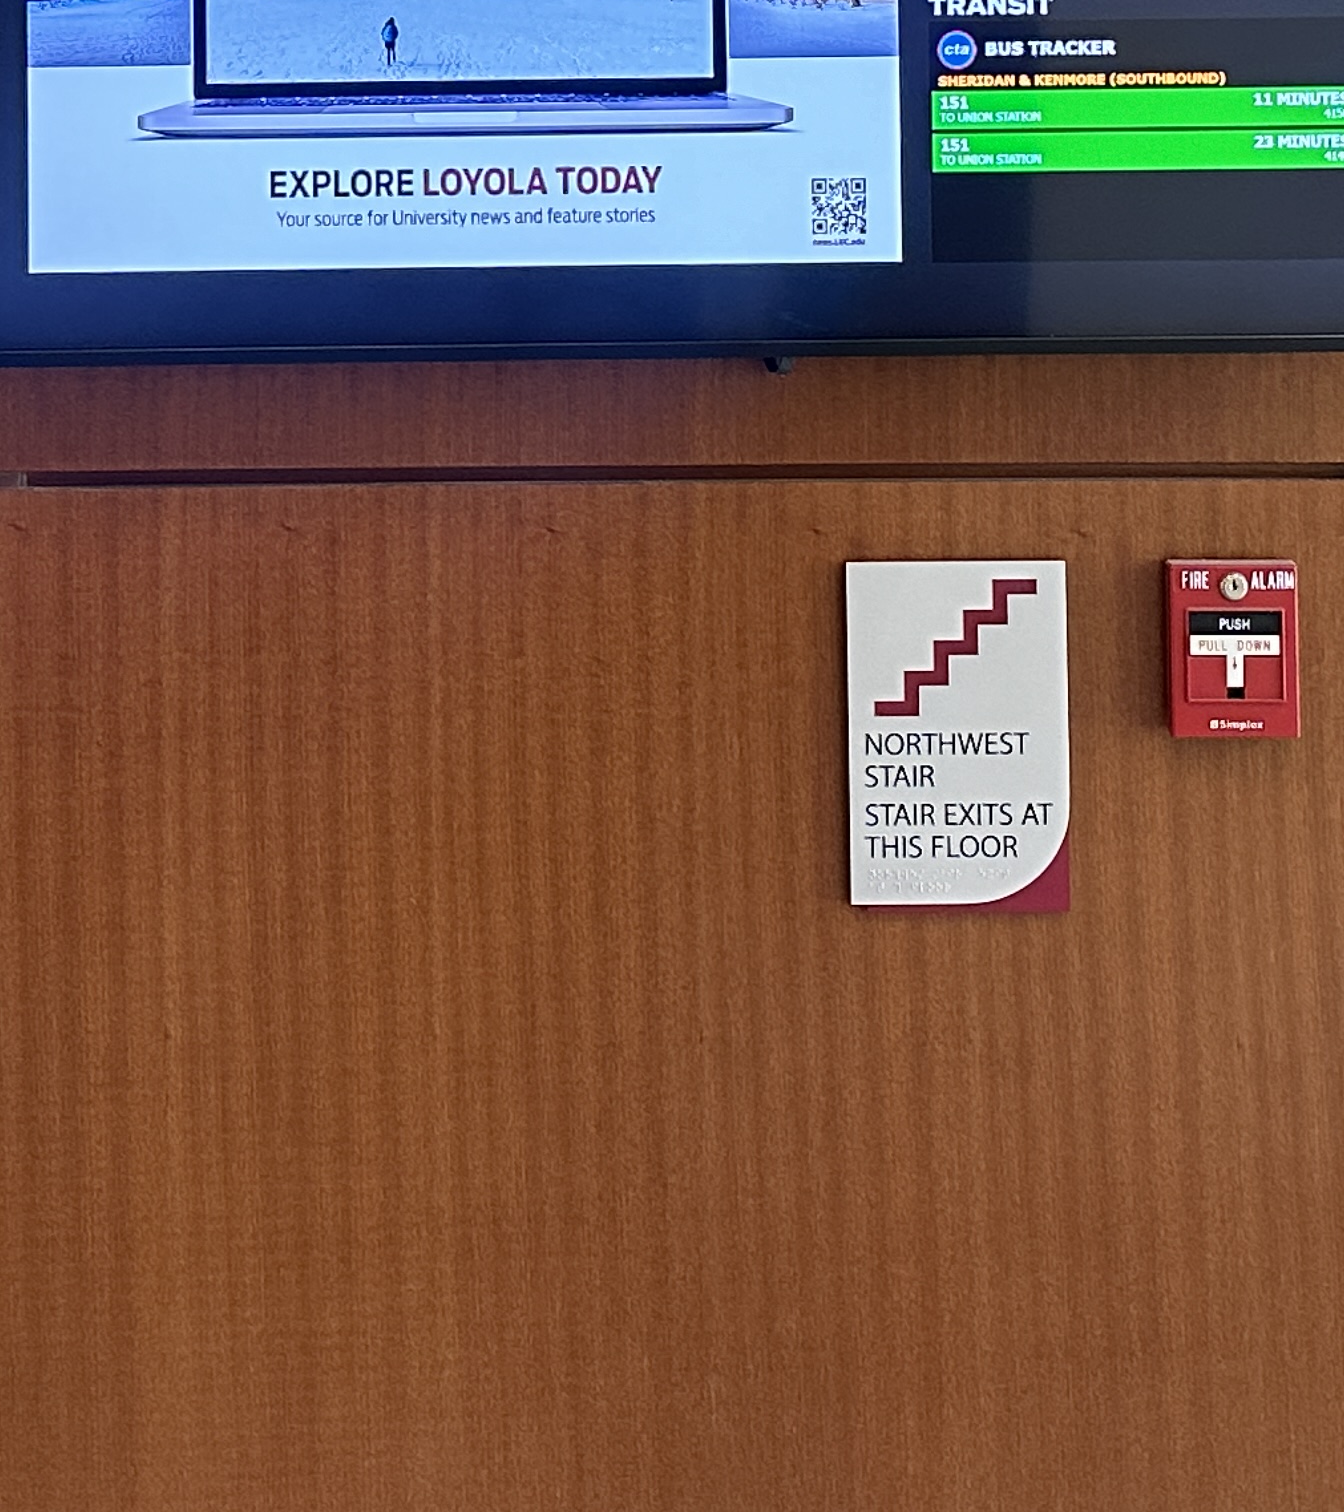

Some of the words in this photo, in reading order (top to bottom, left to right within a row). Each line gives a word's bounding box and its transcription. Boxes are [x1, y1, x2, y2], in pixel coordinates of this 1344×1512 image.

[943, 43, 970, 56] cta
[985, 41, 1024, 56] BUS
[1028, 39, 1116, 56] TRACKER
[937, 74, 1015, 87] SHERIDAN
[1019, 74, 1032, 86] &
[1034, 73, 1106, 86] KENMORE
[1109, 71, 1227, 87] (SOUTHBOUND)
[939, 96, 969, 110] 151
[1253, 92, 1273, 106] 11
[939, 113, 955, 123] TO
[957, 112, 993, 122] UNION
[995, 111, 1041, 122] STATION
[940, 138, 970, 152] 151
[1253, 134, 1274, 149] 23
[941, 155, 956, 165] TO
[958, 154, 994, 165] UNION
[996, 154, 1042, 165] STATION
[270, 169, 414, 198] EXPLORE
[422, 167, 548, 197] LOYOLA
[555, 165, 663, 195] TODAY
[276, 210, 311, 227] Your
[314, 212, 363, 226] source
[367, 210, 389, 226] for
[392, 208, 467, 228] University
[471, 210, 510, 224] news
[514, 208, 543, 224] and
[547, 207, 602, 224] feature
[606, 206, 656, 223] stories
[1181, 571, 1209, 589] FIRE
[1250, 571, 1295, 589] ALARM
[1219, 618, 1251, 631] PUSH
[1198, 640, 1228, 652] PULL
[1237, 640, 1271, 652] DOWN
[865, 732, 1029, 756] NORTHWEST
[865, 765, 935, 788] STAIR
[865, 803, 935, 827] STAIR
[944, 803, 1013, 826] EXITS
[1022, 803, 1053, 826] AT
[865, 836, 923, 859] THIS
[931, 835, 1018, 858] FLOOR
